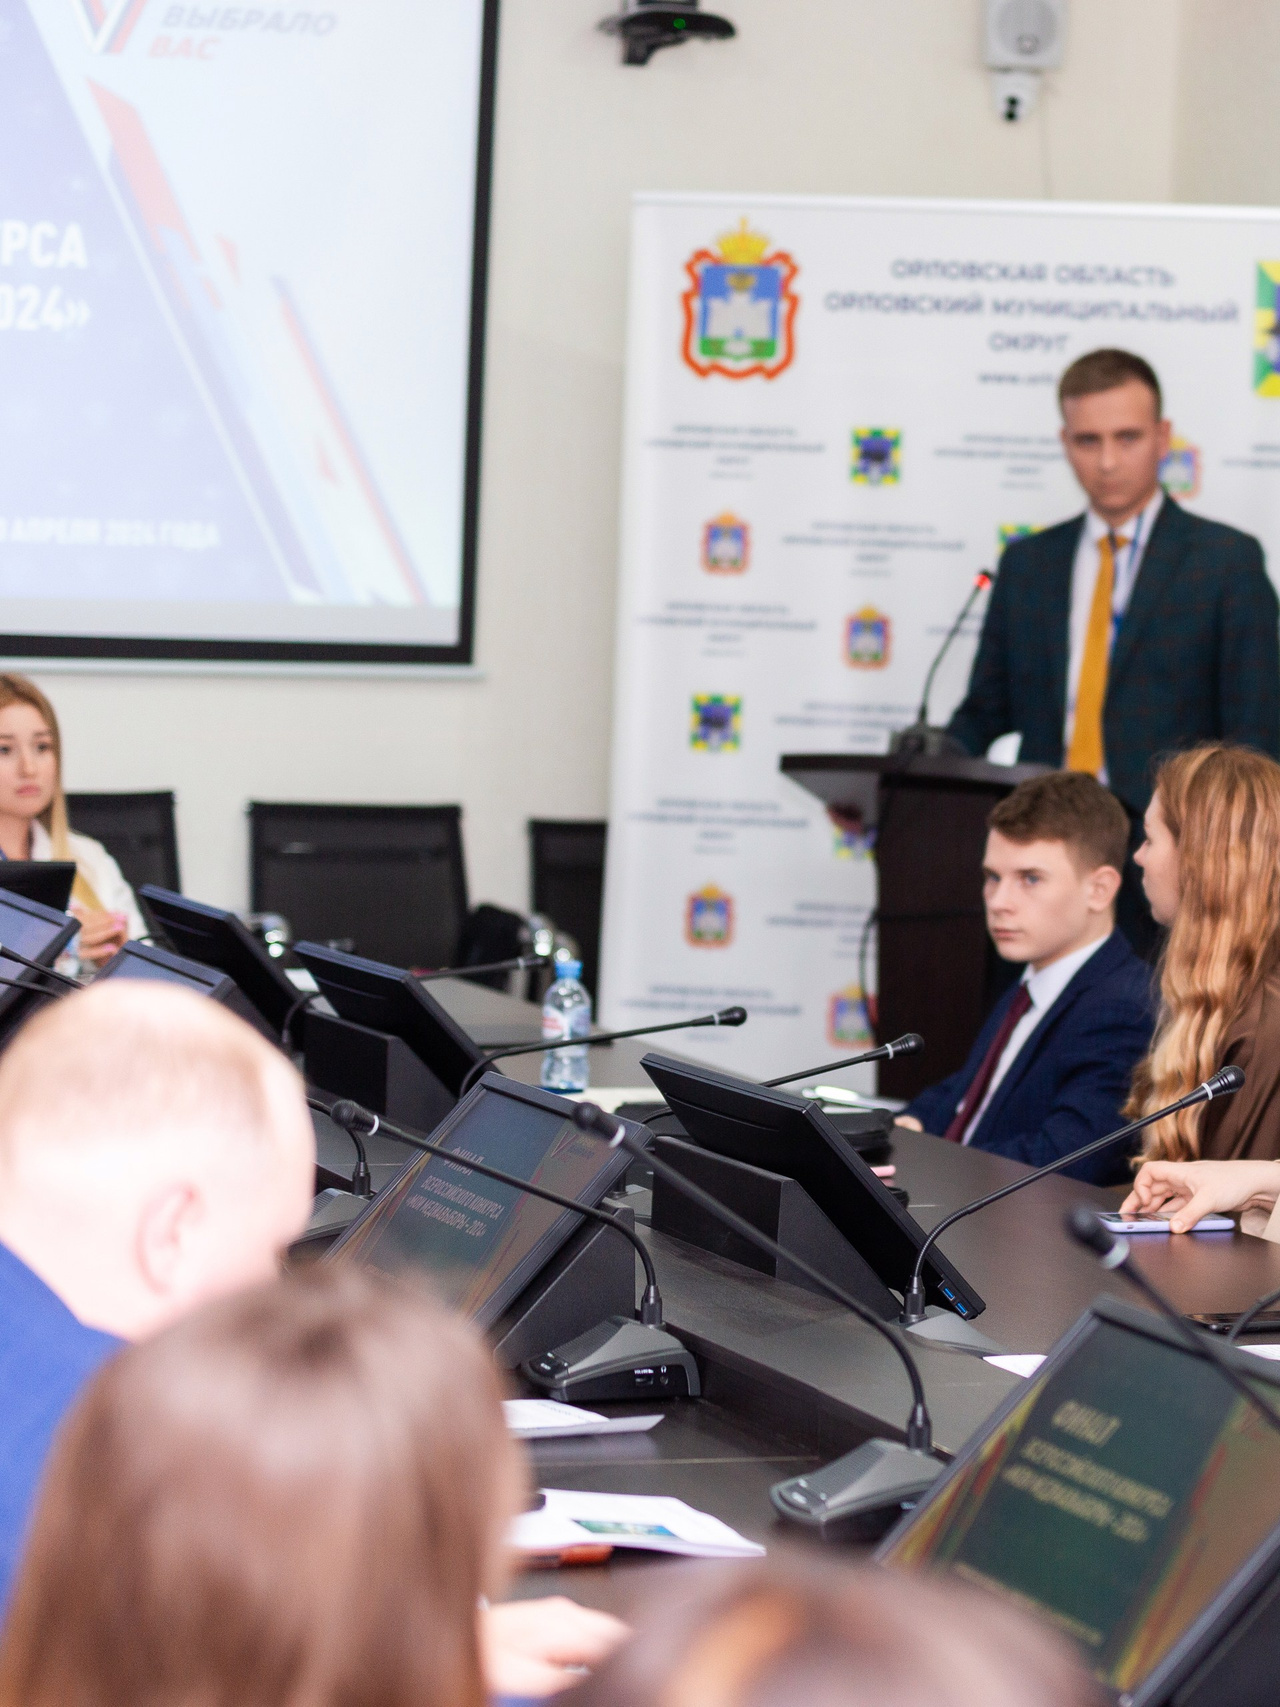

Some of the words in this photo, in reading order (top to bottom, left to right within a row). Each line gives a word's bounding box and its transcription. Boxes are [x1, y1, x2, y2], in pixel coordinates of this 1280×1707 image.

[163, 4, 336, 36] ВЫБРАЛО
[148, 37, 220, 60] ВАС
[891, 256, 1048, 284] ОРЛОВСКАЯ
[1054, 264, 1176, 288] ОБЛАСТЬ
[824, 290, 984, 316] ОРЛОВСКИЙ
[991, 294, 1240, 324] МУНИЦИПАЛЬНЫЙ
[987, 331, 1070, 354] ОКРУГ
